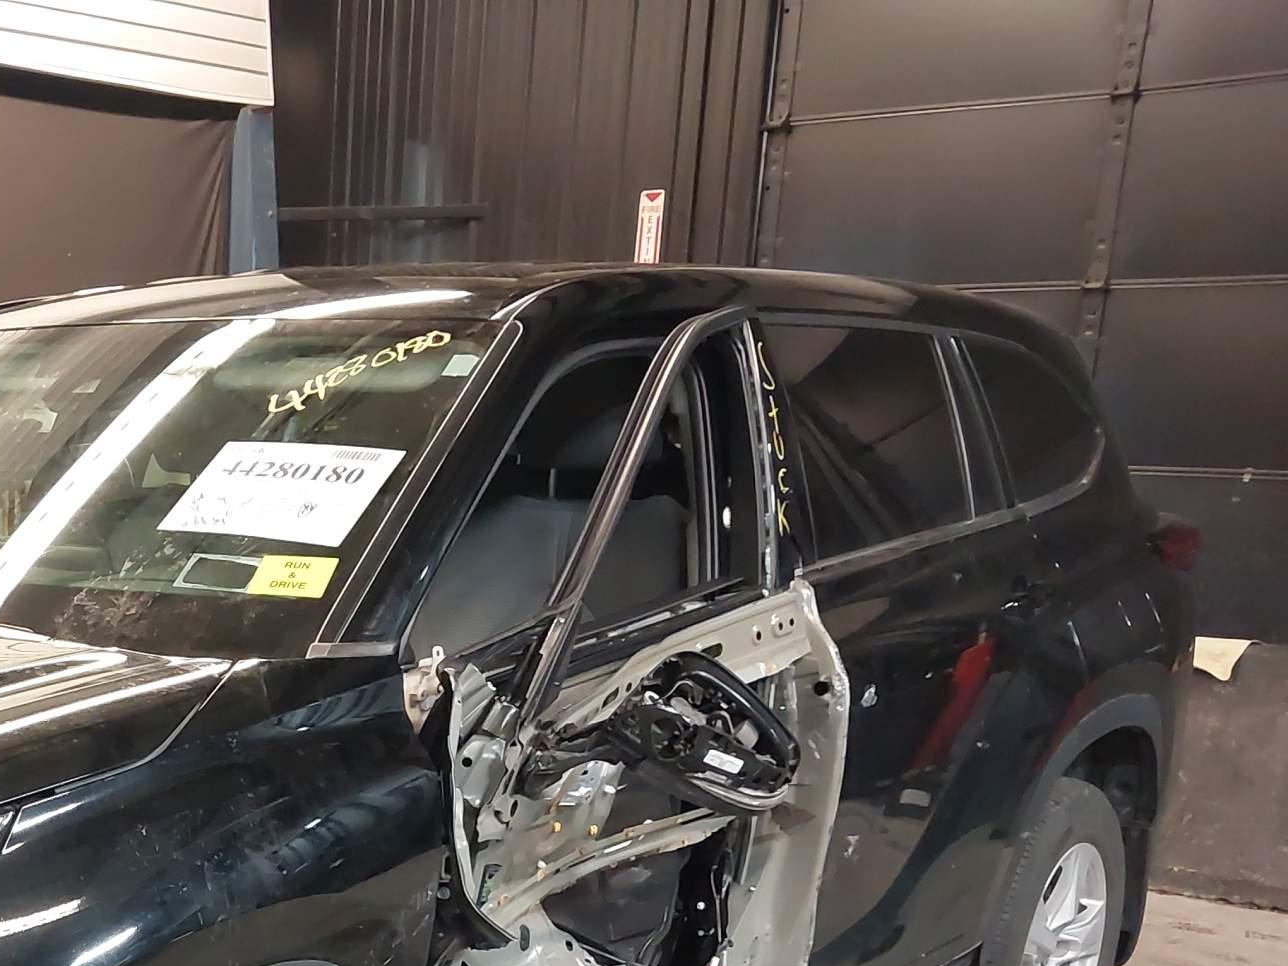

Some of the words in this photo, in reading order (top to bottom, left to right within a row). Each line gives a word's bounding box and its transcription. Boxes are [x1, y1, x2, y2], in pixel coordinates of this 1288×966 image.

[268, 330, 451, 413] 44280180
[222, 460, 365, 485] 44280180
[284, 561, 311, 569] RUN
[269, 580, 307, 590] DRIVE
